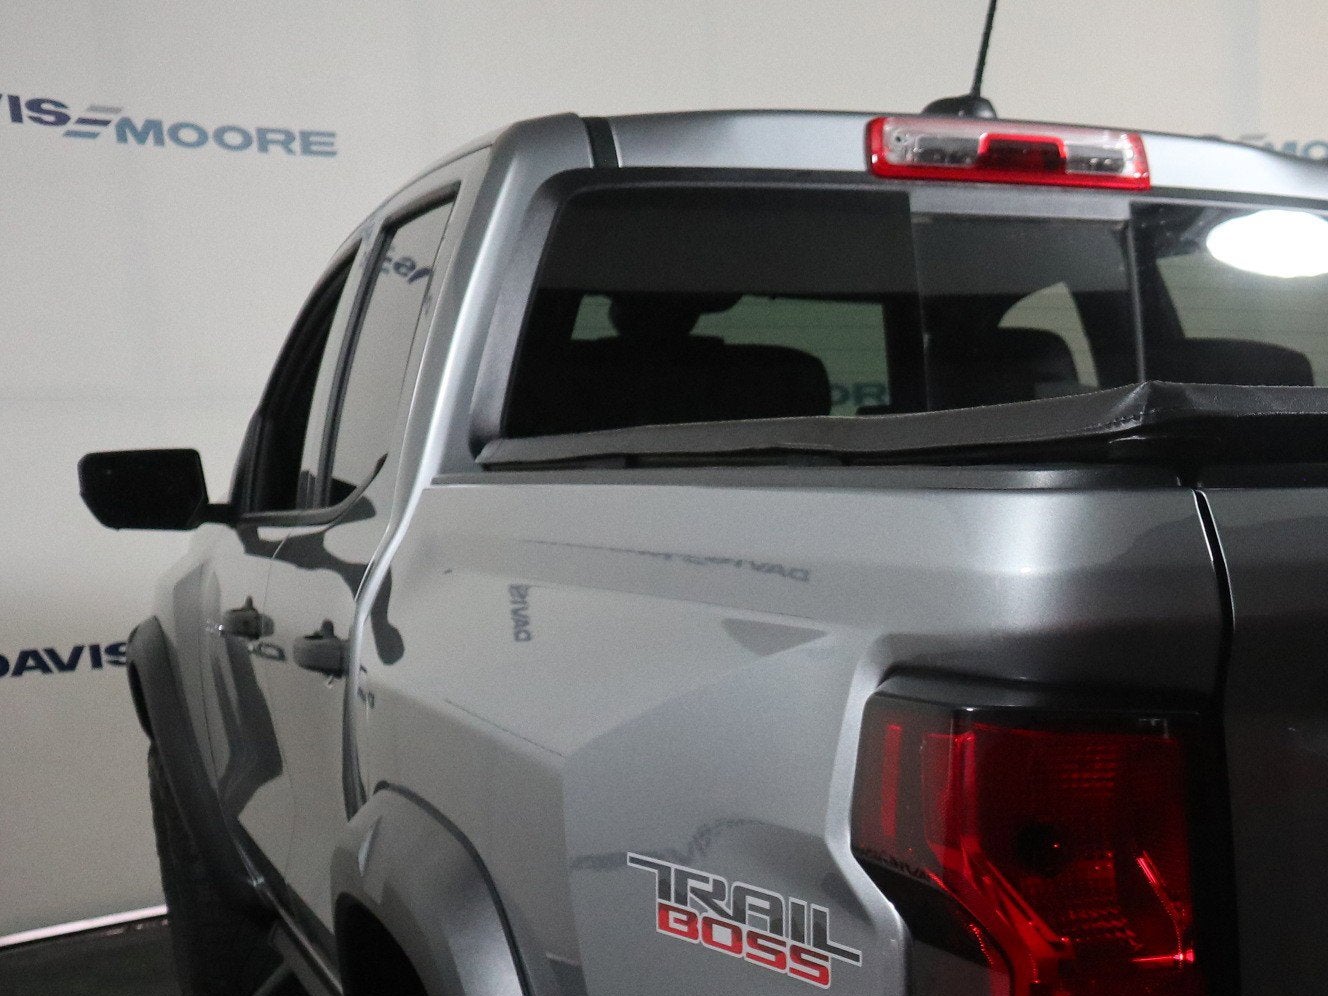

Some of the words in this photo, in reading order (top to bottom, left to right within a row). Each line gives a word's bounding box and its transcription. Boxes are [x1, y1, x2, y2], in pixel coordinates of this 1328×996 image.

[113, 116, 338, 158] MOORE
[627, 852, 862, 967] TRAIL
[656, 900, 832, 989] BOSS
